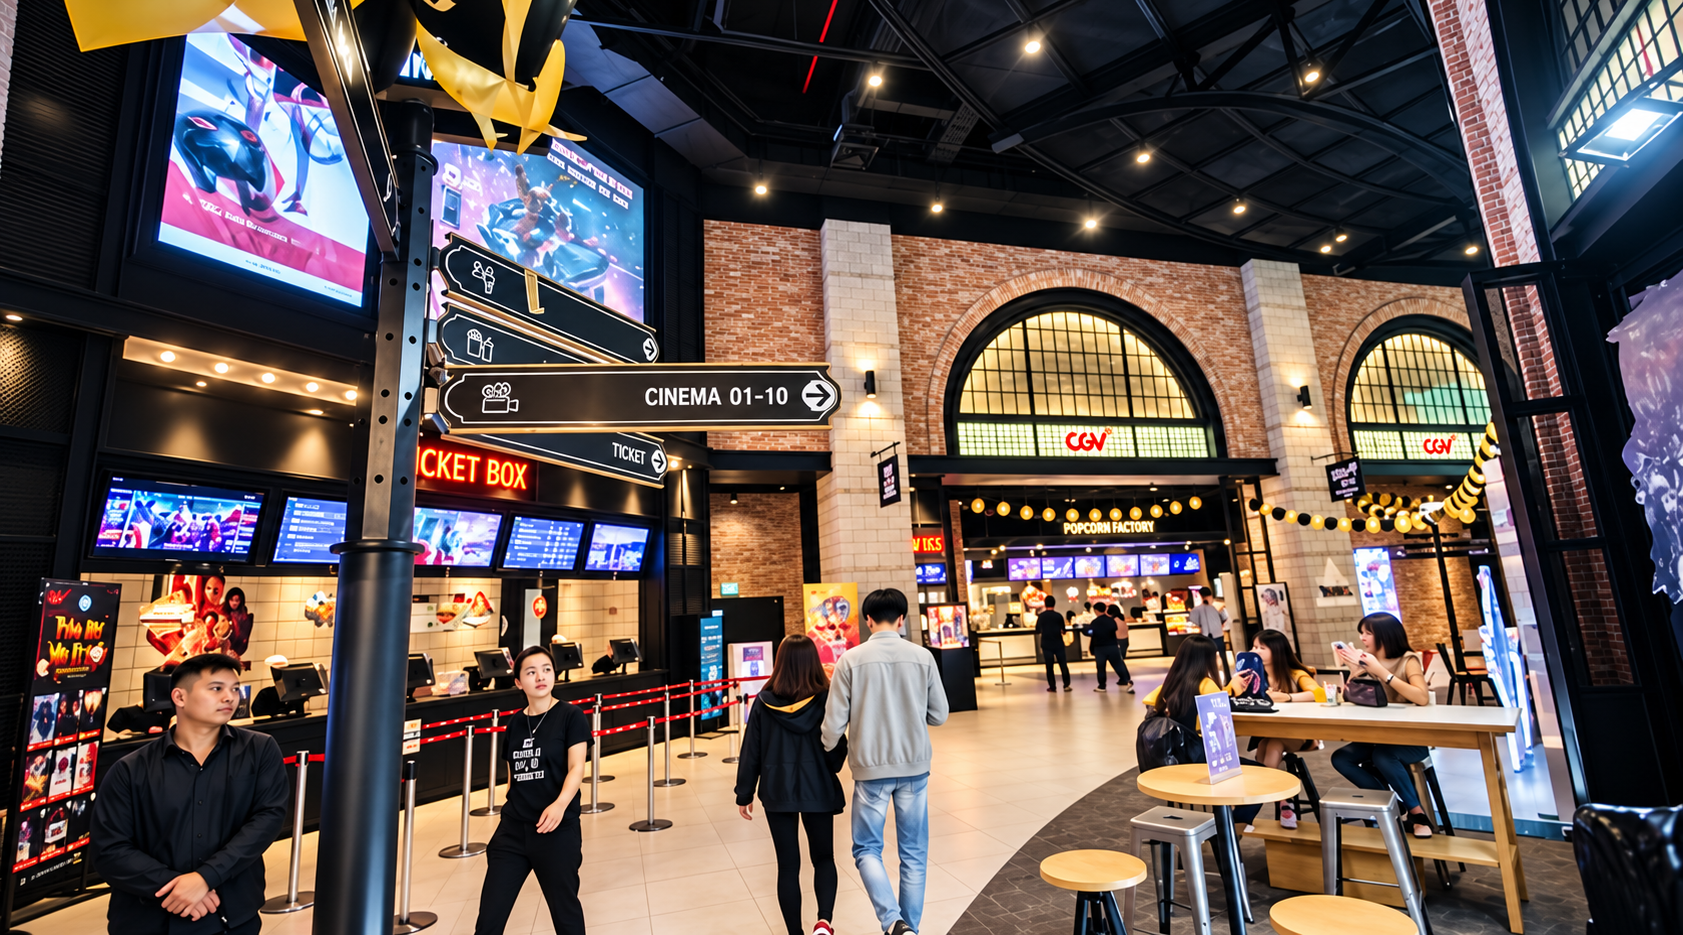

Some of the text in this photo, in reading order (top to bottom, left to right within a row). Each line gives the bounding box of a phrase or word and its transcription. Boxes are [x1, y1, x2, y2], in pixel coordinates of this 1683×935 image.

[645, 387, 788, 406] CINEMA 01-10
[1066, 431, 1107, 451] CGV
[1423, 438, 1452, 455] CGV
[612, 441, 646, 466] TICKET
[416, 446, 528, 490] ICKET BOX
[1063, 520, 1155, 535] POPCORN FACTORY
